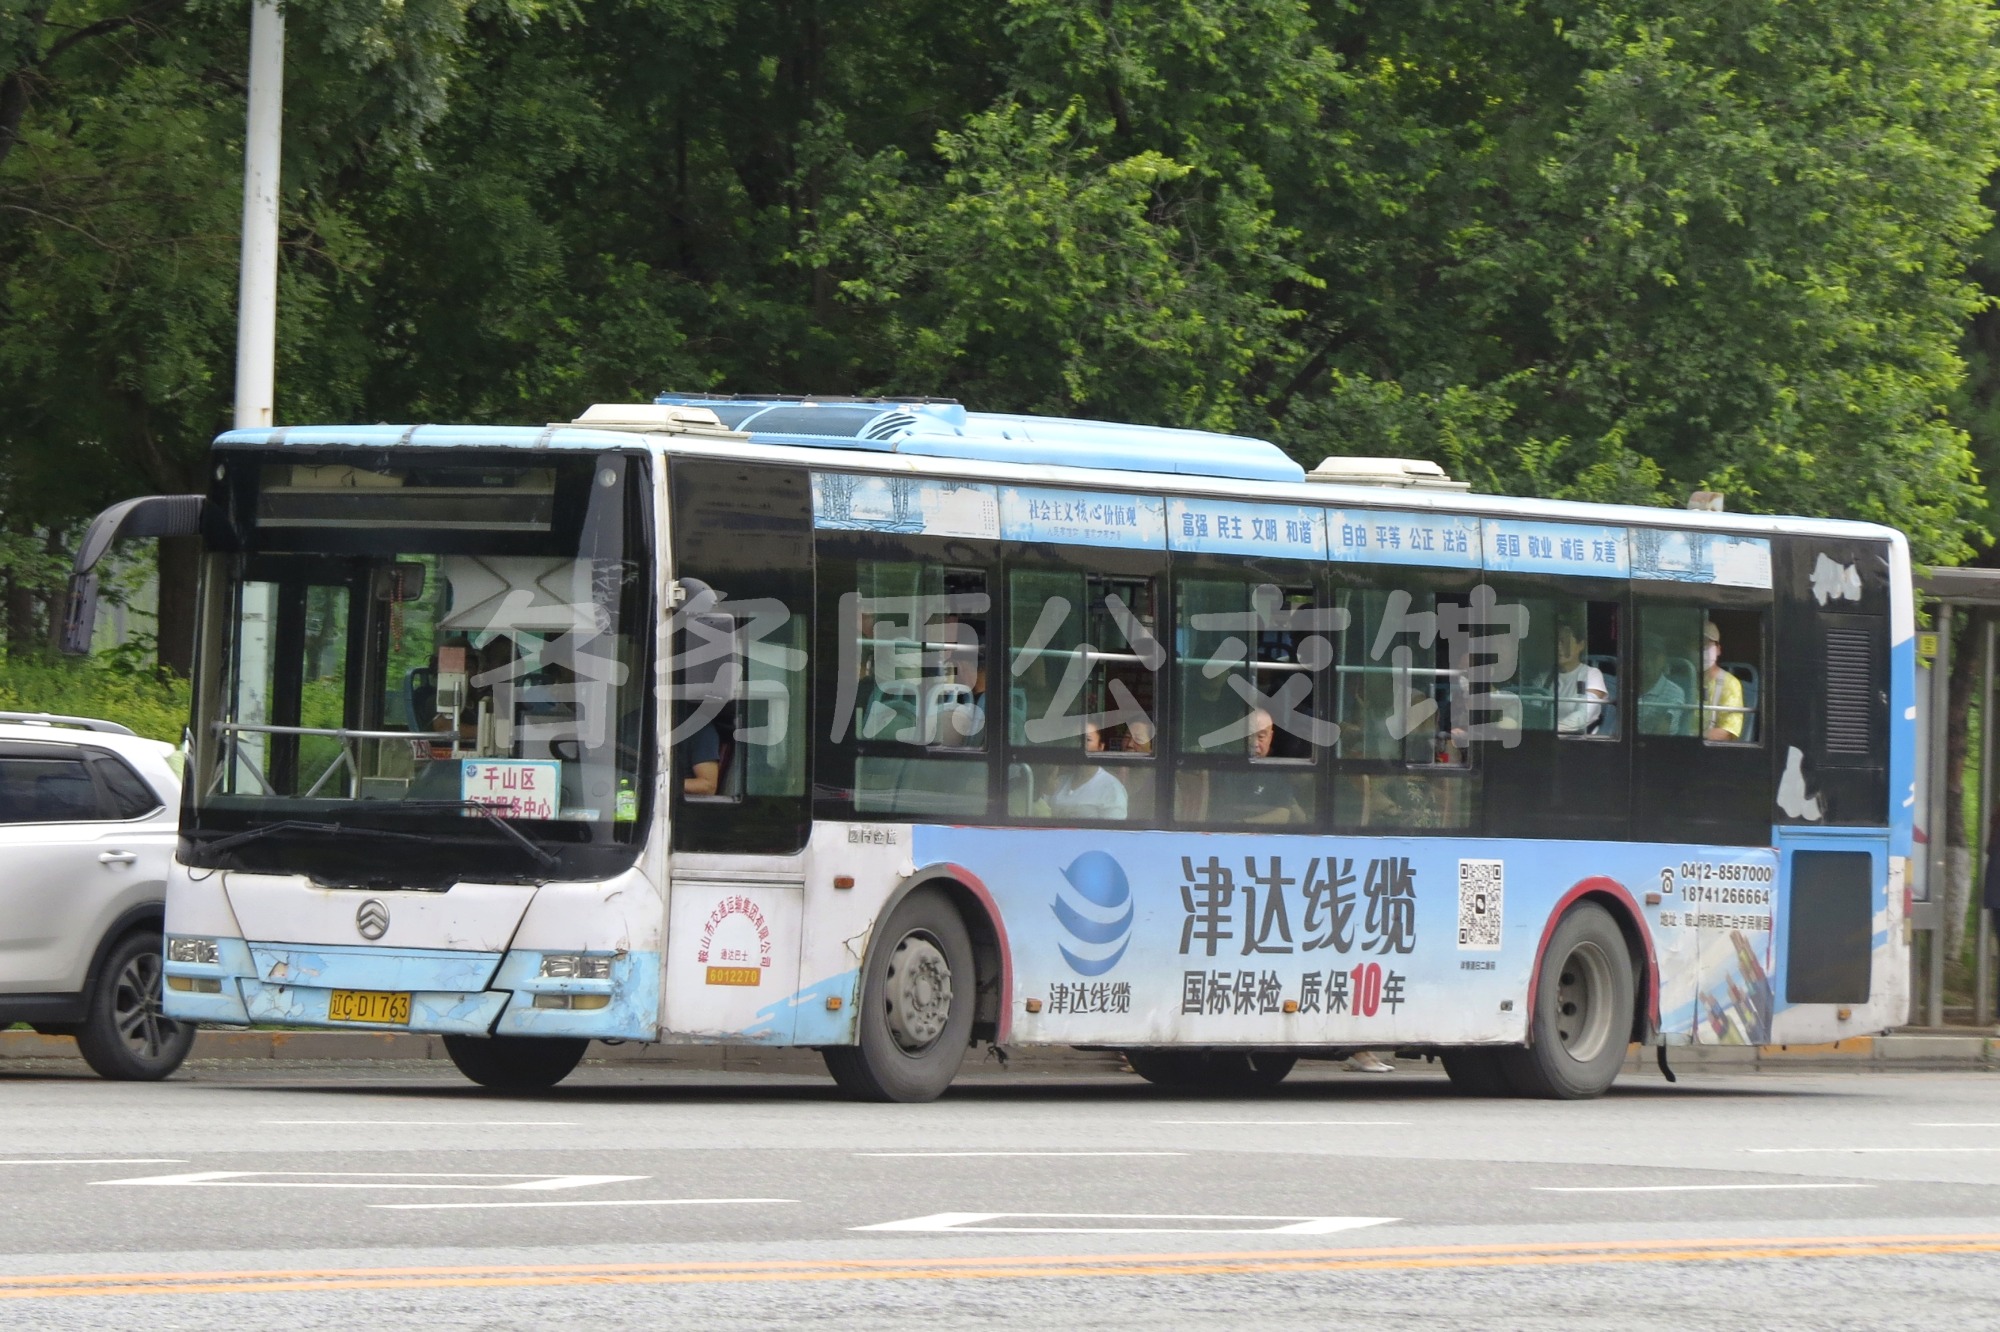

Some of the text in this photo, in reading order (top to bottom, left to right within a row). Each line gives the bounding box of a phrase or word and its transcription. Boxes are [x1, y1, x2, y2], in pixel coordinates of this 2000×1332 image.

[1029, 499, 1137, 527] 社会主义核心价值观
[1182, 512, 1311, 544] 富强 民主 文明 和谐
[1342, 524, 1467, 552] 自由 平等 公正 法治
[1496, 534, 1616, 563] 爱国 敬业 诚信 友善
[484, 767, 535, 790] 千山区
[1681, 863, 1771, 882] 0412-8587000
[1179, 856, 1417, 957] 津达线缆
[1681, 886, 1769, 905] 18741266664
[698, 894, 771, 967] 鞍山市交通运输集团有限公司
[710, 969, 758, 982] 6012270
[1181, 962, 1406, 1017] 国标保检 质保10年
[1048, 982, 1132, 1015] 津达线缆
